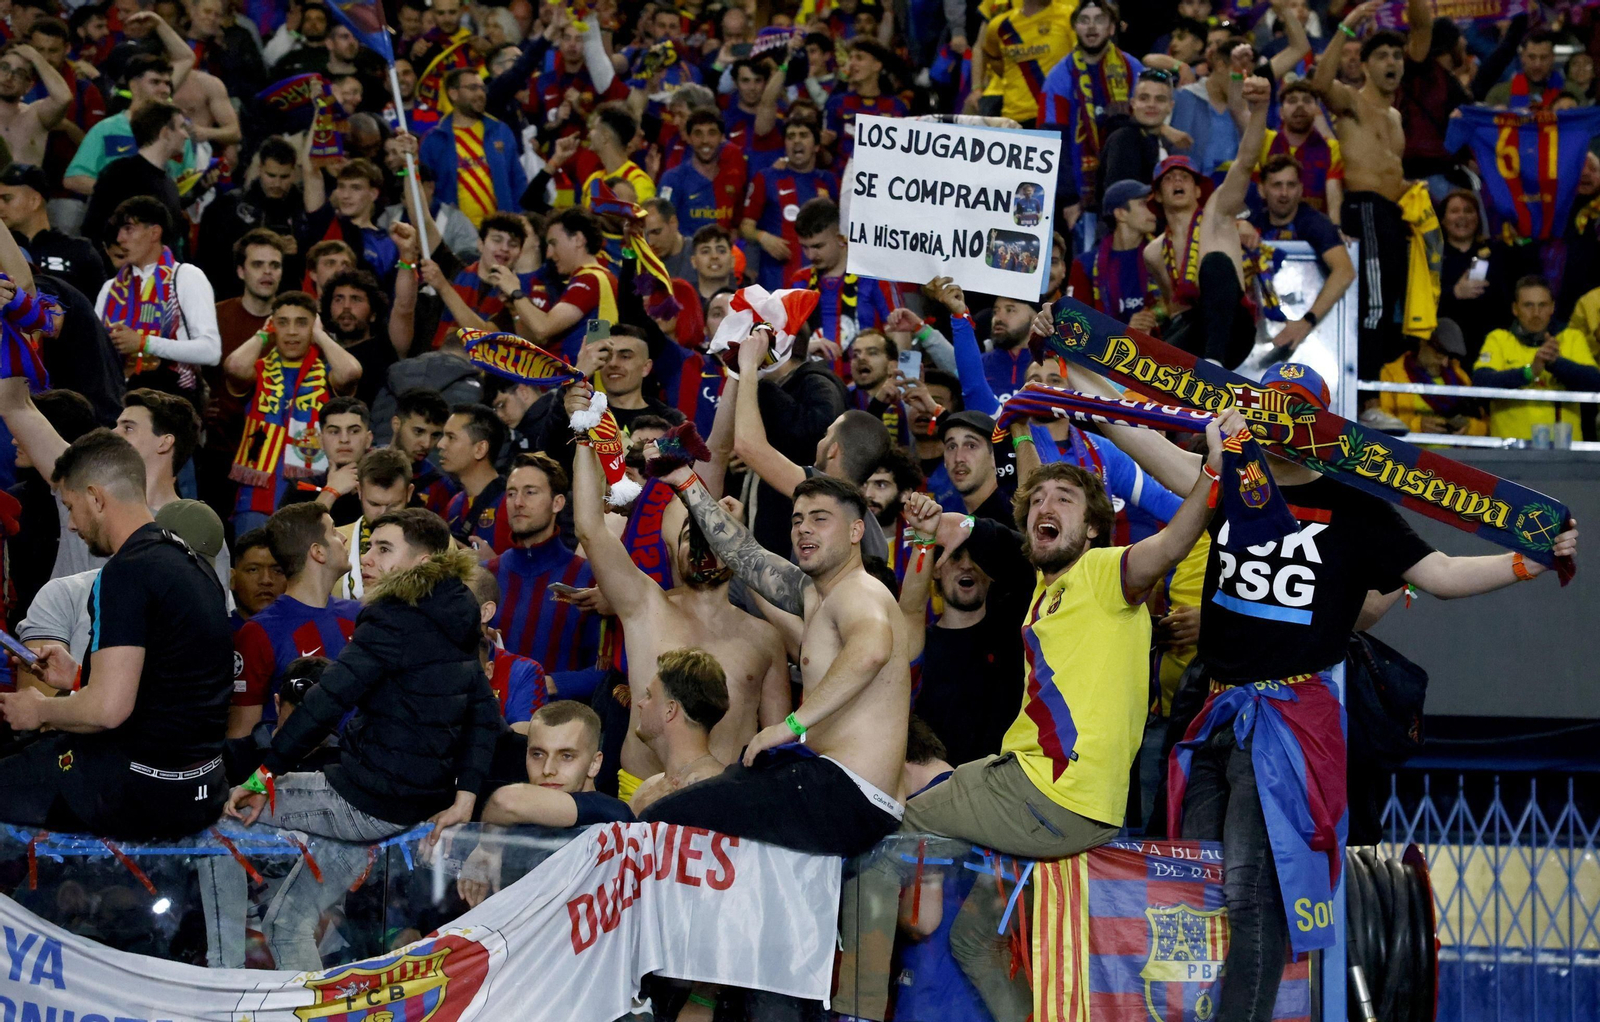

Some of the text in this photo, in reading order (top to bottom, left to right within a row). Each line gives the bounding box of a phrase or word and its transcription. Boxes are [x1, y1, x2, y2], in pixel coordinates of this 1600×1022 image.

[858, 122, 1055, 174] LOS JUGADORES
[1495, 126, 1558, 179] 61
[690, 204, 733, 219] unicef
[854, 171, 1012, 213] SE COMPRAN
[849, 222, 867, 244] LA
[952, 230, 984, 258] NO
[1089, 335, 1237, 413] Nostra
[1218, 550, 1316, 608] PSG
